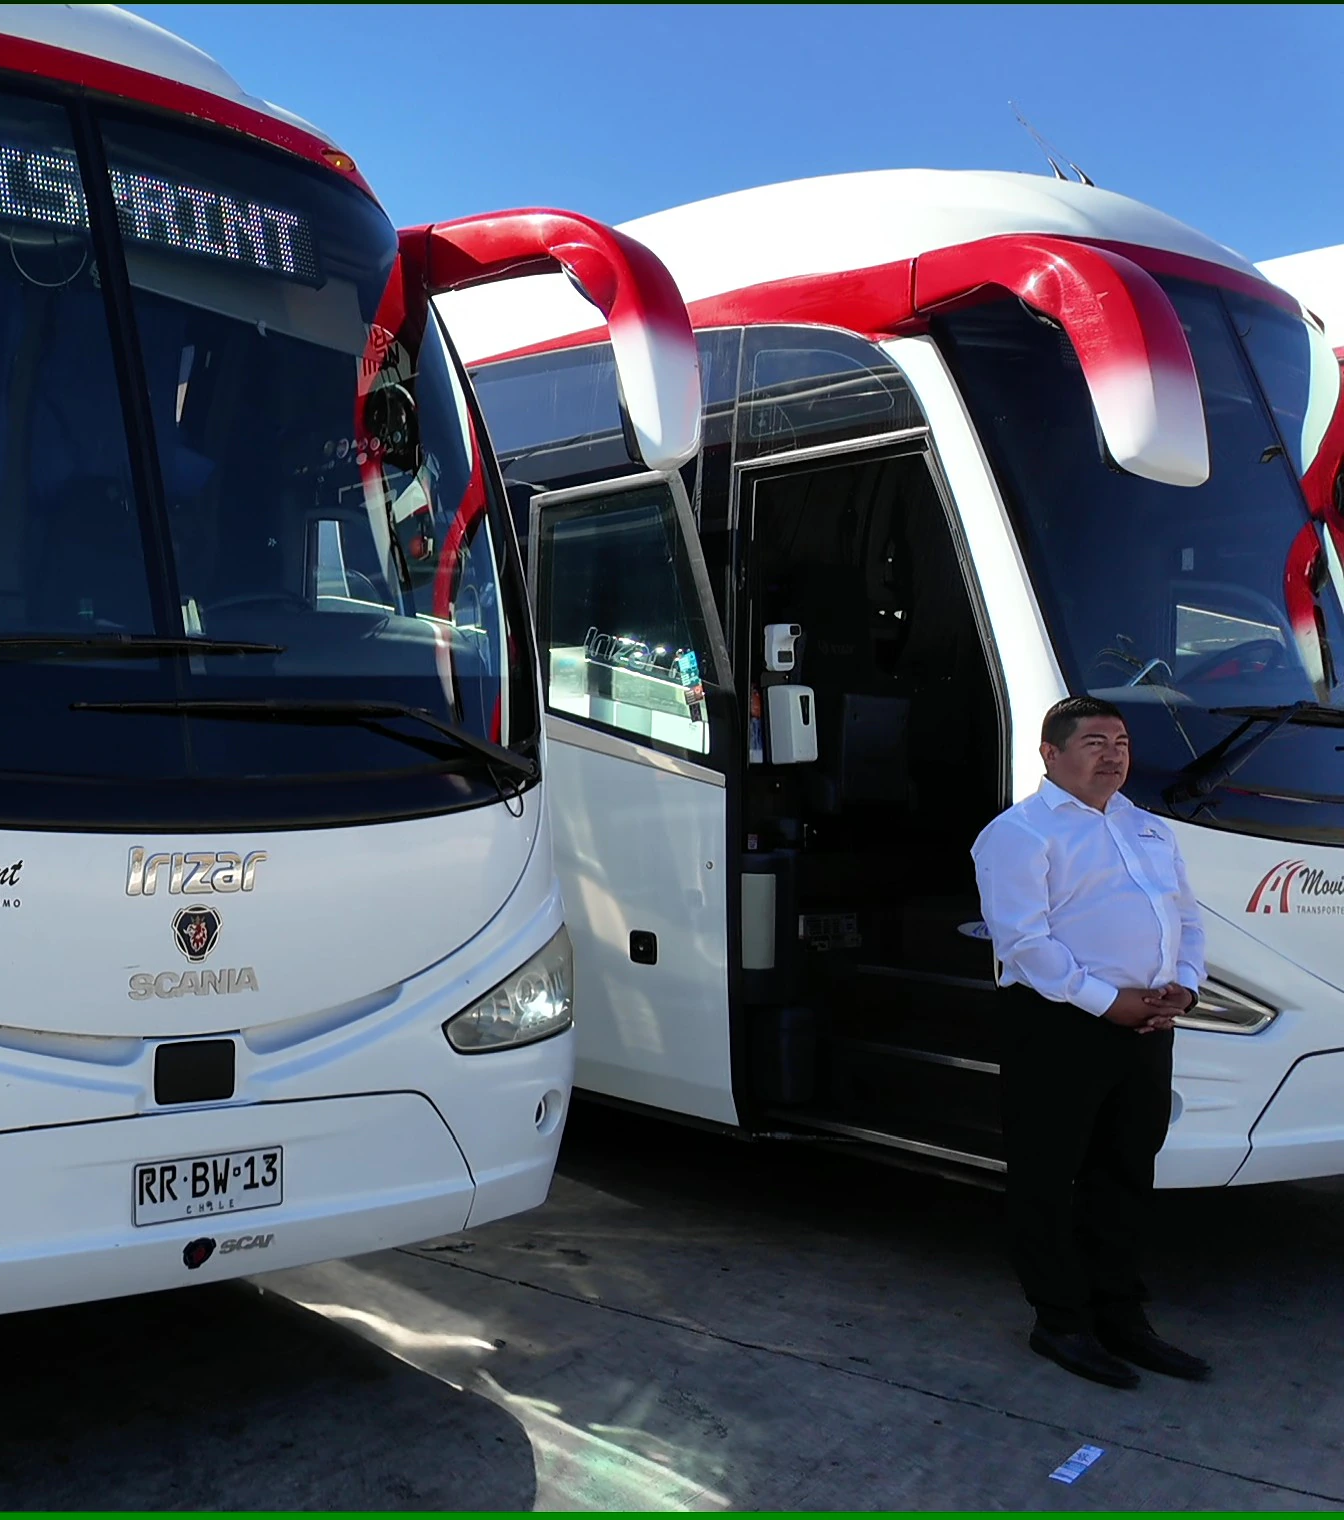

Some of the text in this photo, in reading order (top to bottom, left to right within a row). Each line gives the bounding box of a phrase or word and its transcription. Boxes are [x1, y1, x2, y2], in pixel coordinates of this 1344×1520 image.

[126, 845, 269, 897] Irizar
[128, 966, 260, 1001] SCANIA
[186, 1198, 235, 1215] CHILE
